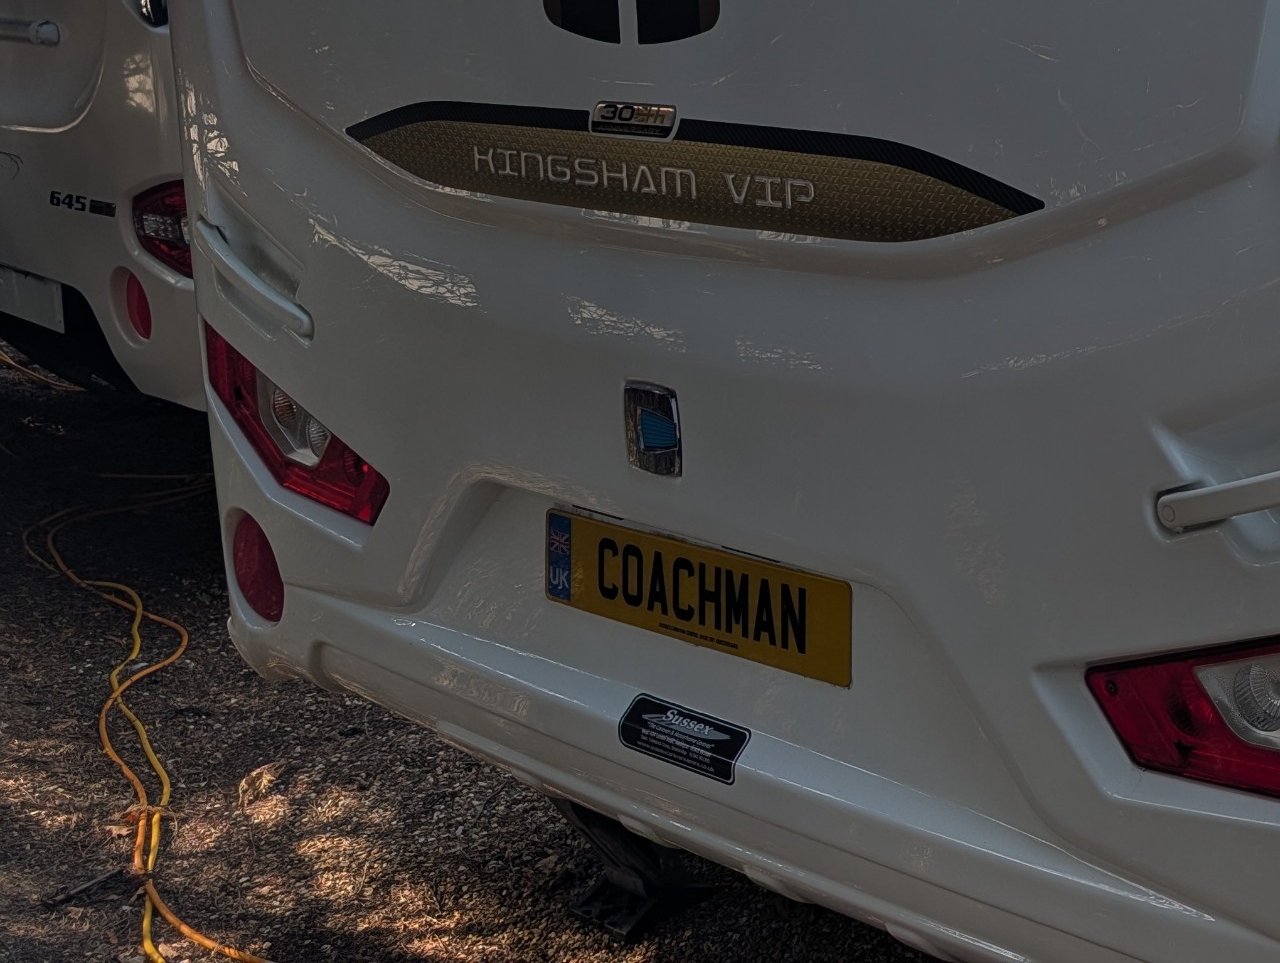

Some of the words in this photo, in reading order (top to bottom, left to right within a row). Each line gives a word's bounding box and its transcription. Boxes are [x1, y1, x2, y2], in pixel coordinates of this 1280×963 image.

[472, 144, 697, 200] KINGSHAM
[723, 171, 815, 209] VIP
[49, 190, 87, 211] 645
[550, 566, 570, 590] UK
[598, 537, 807, 654] COACHMAN
[662, 709, 714, 734] Sussex
